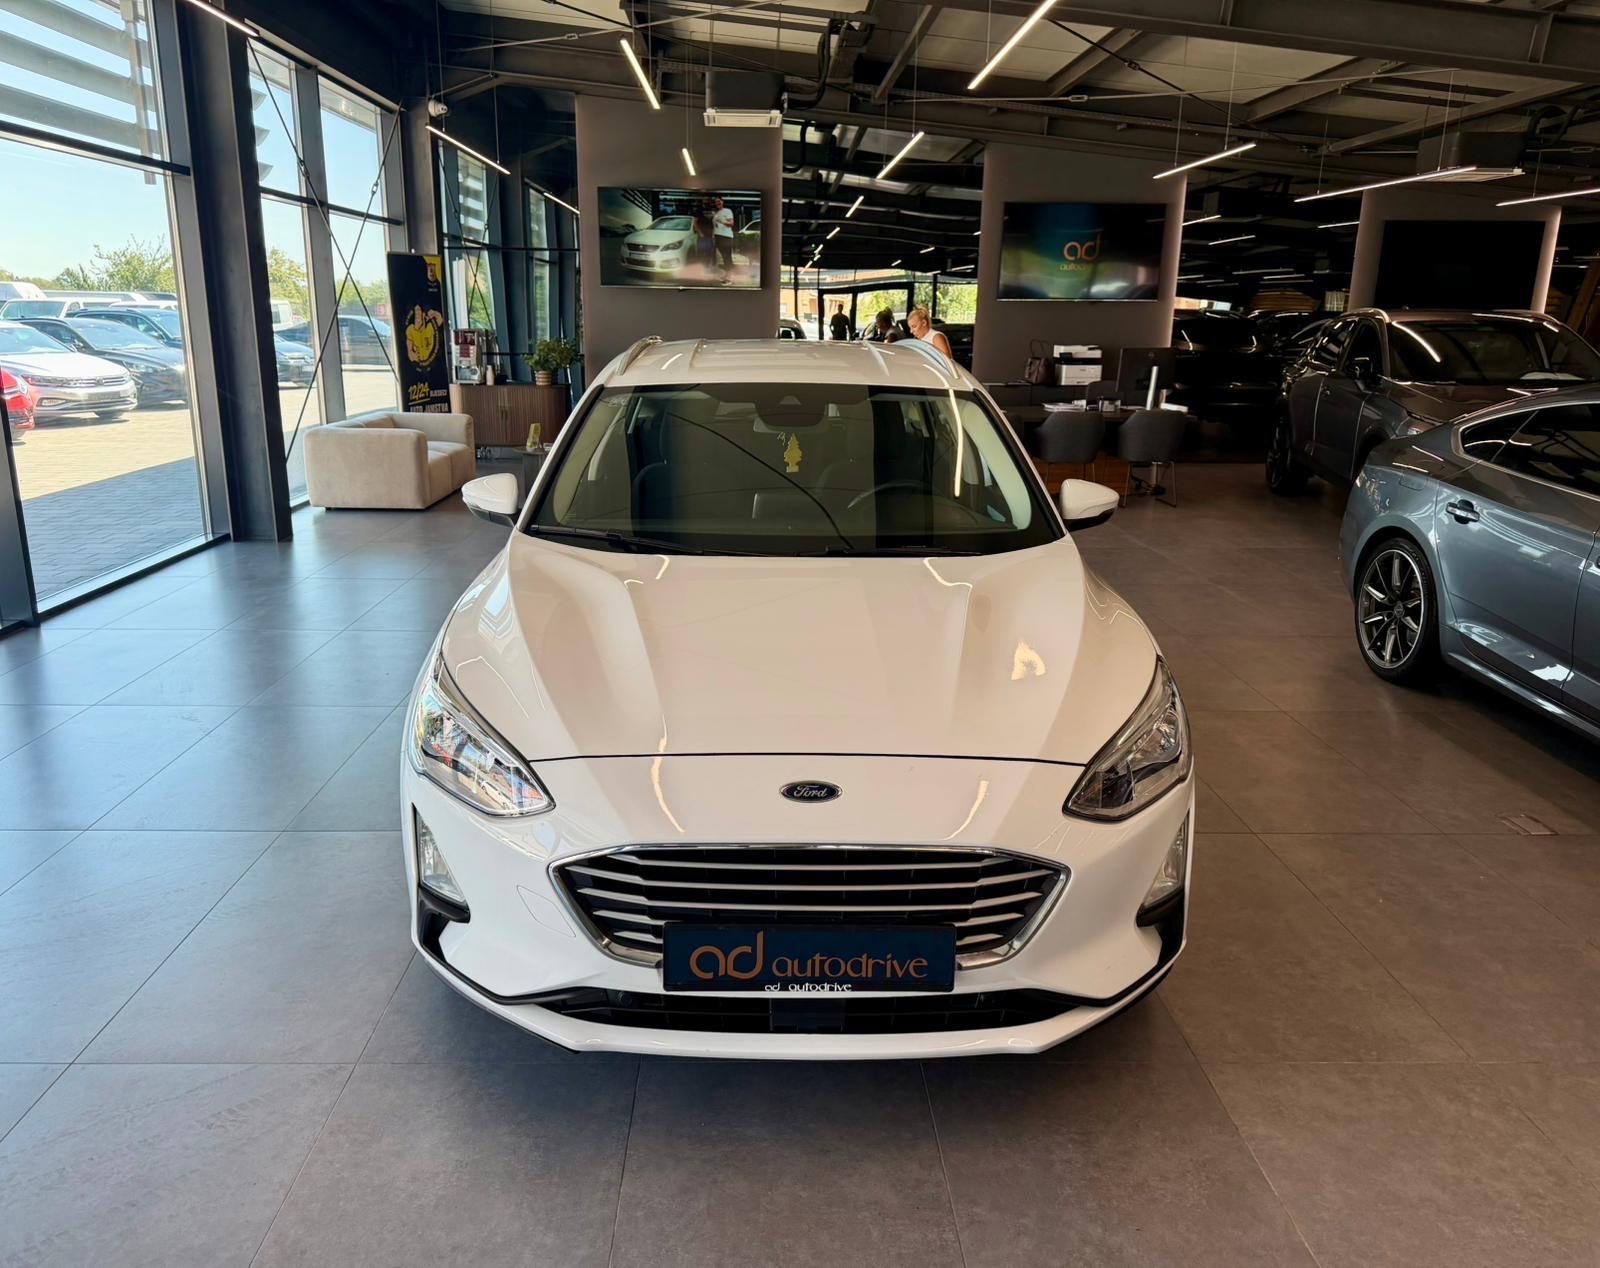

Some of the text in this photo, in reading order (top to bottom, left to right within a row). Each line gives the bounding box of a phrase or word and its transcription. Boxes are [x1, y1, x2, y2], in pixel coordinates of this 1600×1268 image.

[1063, 233, 1102, 261] ad
[793, 784, 828, 798] Ford
[689, 930, 929, 980] ad autodrive
[764, 981, 852, 992] ad autodrive
